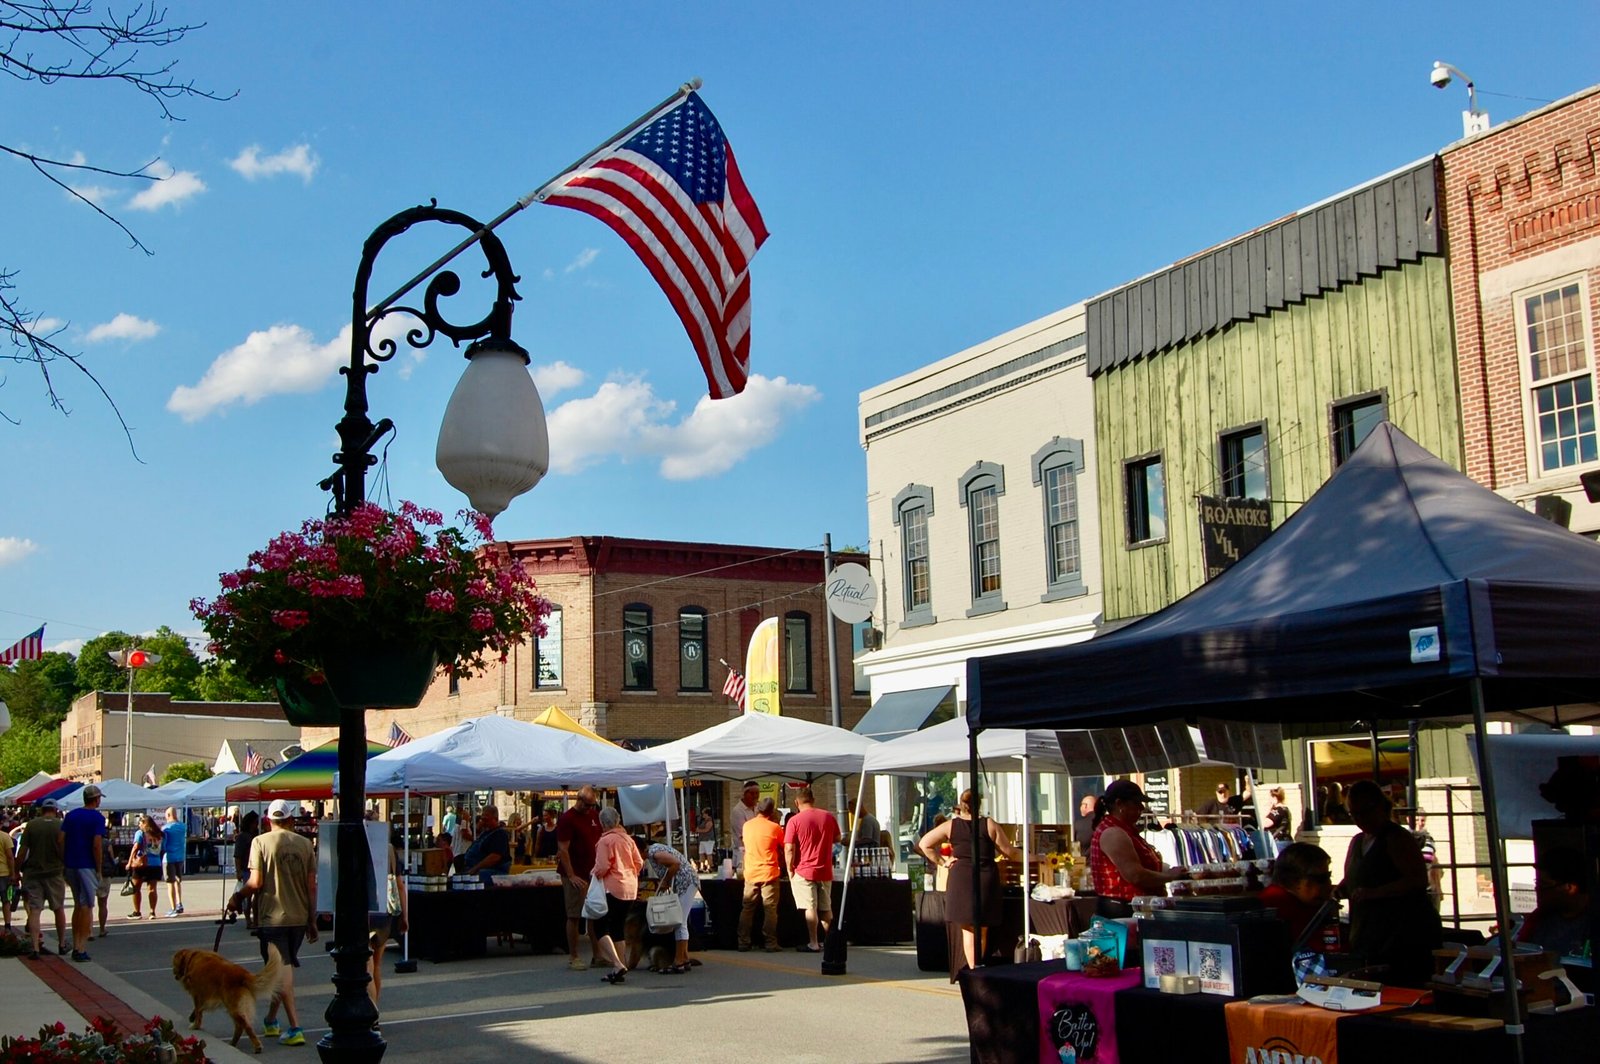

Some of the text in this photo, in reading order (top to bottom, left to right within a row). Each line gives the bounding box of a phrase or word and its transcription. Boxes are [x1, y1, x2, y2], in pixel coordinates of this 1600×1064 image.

[1204, 506, 1269, 527] ROANOKE
[827, 579, 877, 602] Ritual
[1053, 1009, 1095, 1039] Batter
[1072, 1031, 1095, 1058] Up!
